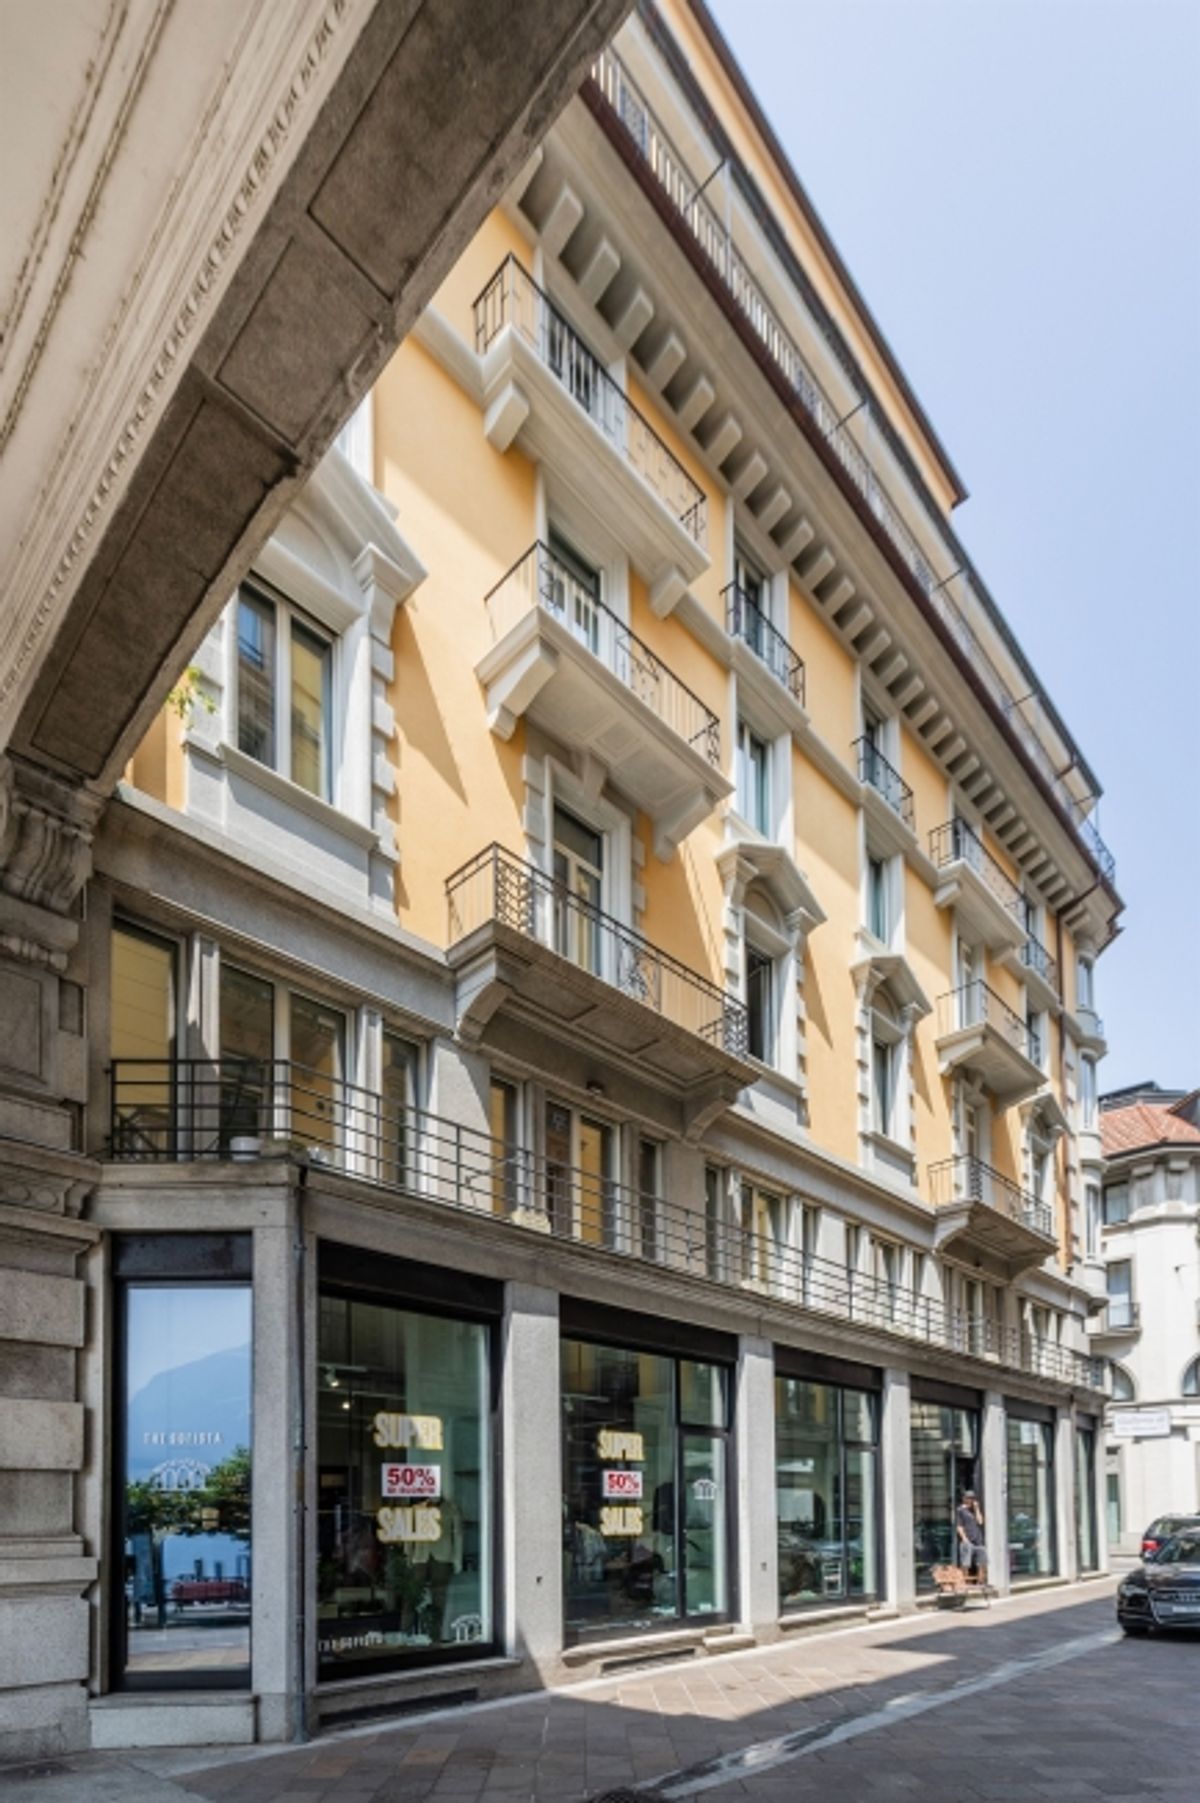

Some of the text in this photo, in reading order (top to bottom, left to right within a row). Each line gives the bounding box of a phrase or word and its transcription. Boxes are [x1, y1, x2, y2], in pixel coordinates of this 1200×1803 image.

[374, 1412, 444, 1450] SUPER
[598, 1430, 645, 1461] SUPER
[387, 1467, 436, 1486] 50%
[608, 1473, 640, 1489] 50%
[376, 1506, 442, 1542] SALES
[600, 1506, 643, 1536] SALES
